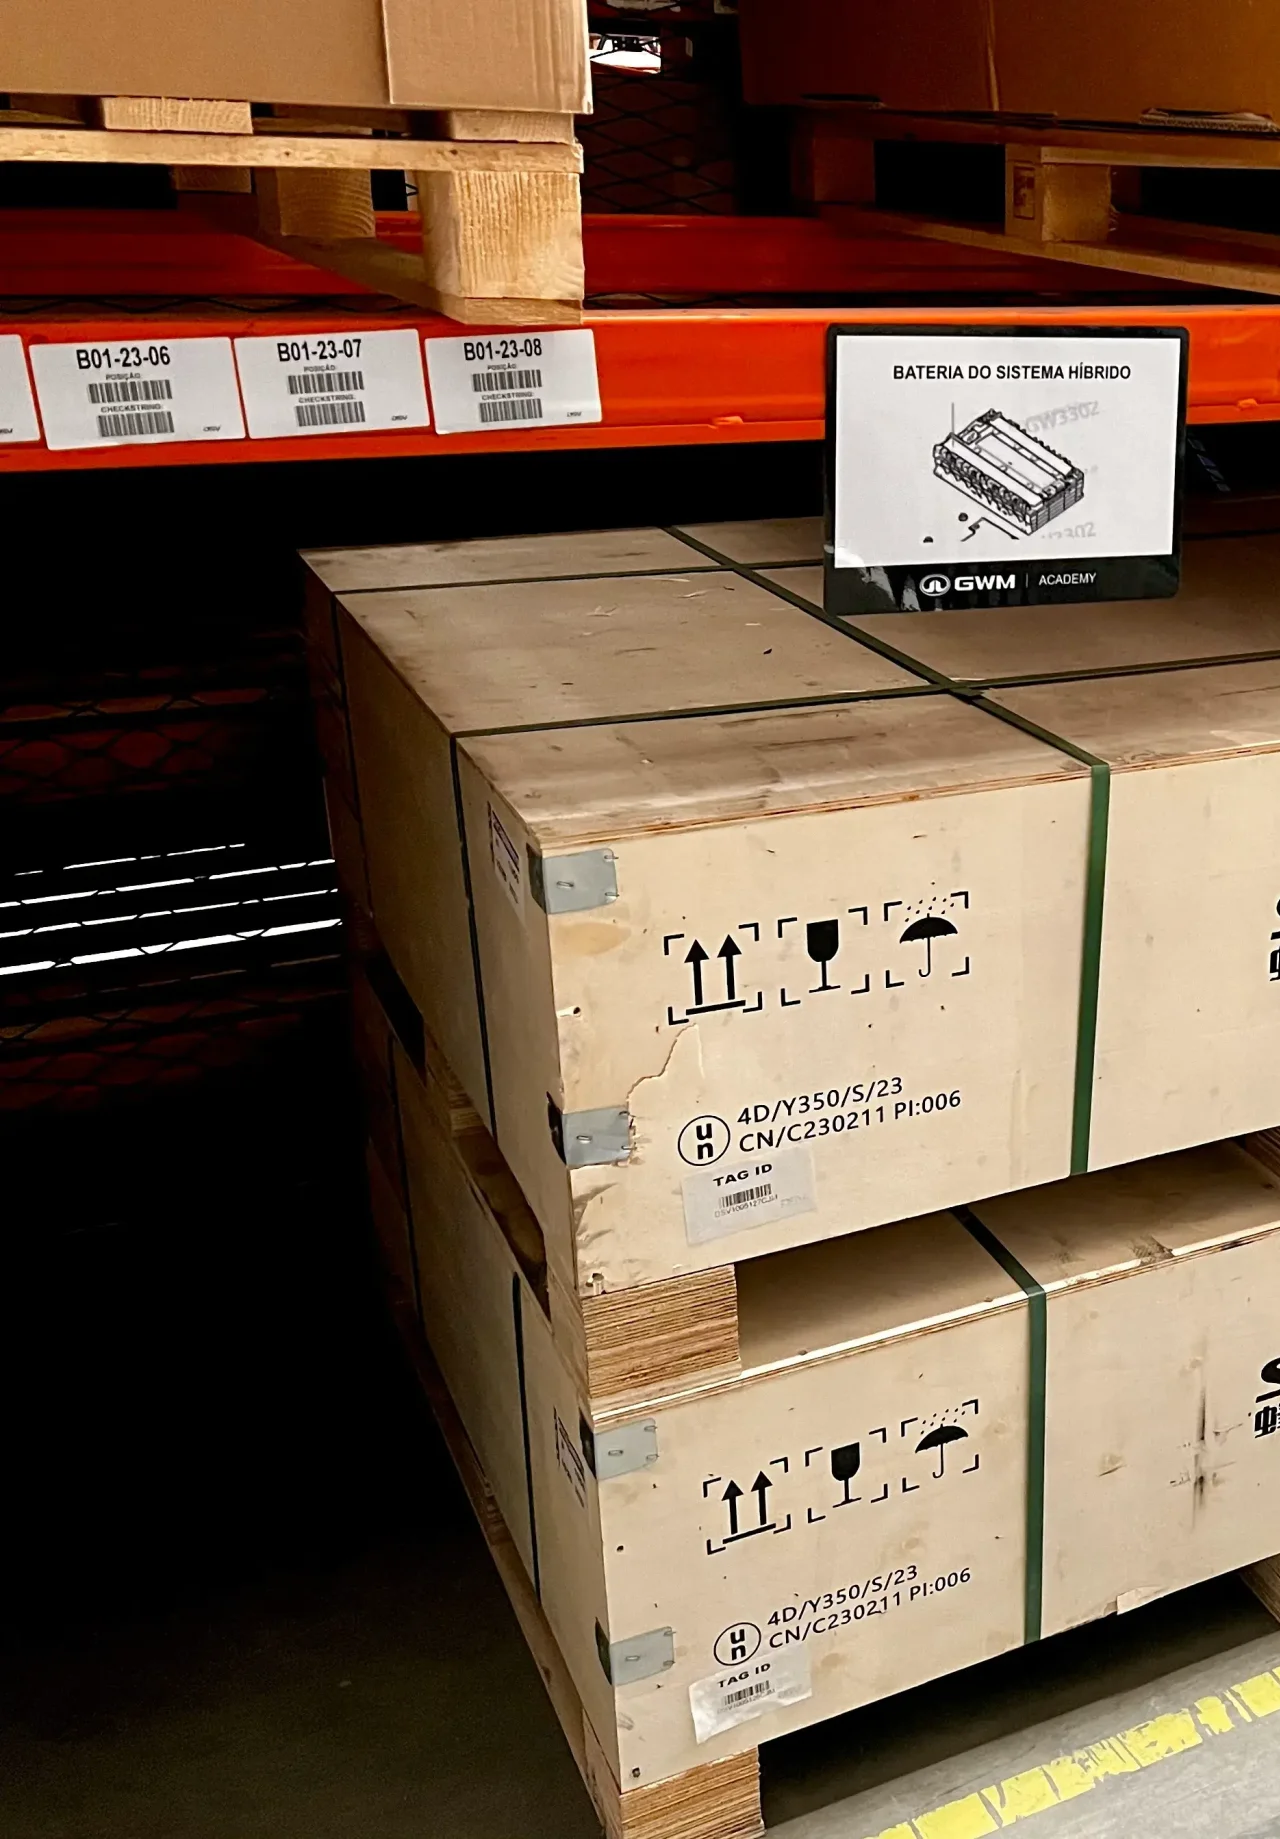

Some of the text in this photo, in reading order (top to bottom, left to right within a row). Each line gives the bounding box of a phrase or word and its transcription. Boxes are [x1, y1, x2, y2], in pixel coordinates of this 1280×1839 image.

[76, 345, 171, 369] B01-23-06
[277, 339, 362, 362] B01-23-07
[464, 338, 542, 361] B01-23-08
[893, 362, 1131, 380] BATERIA DO SISTEMA HÍBRIDO
[954, 572, 1097, 592] GWM ACADEMY
[737, 1077, 903, 1125] 4D/Y350/S/23
[739, 1090, 961, 1152] CN/C230211 PI:006
[713, 1163, 773, 1187] TAG ID
[767, 1565, 918, 1626] 4D/Y350/S/23
[769, 1567, 971, 1648] CN/C230211 PI:006
[717, 1663, 771, 1688] TAG ID
